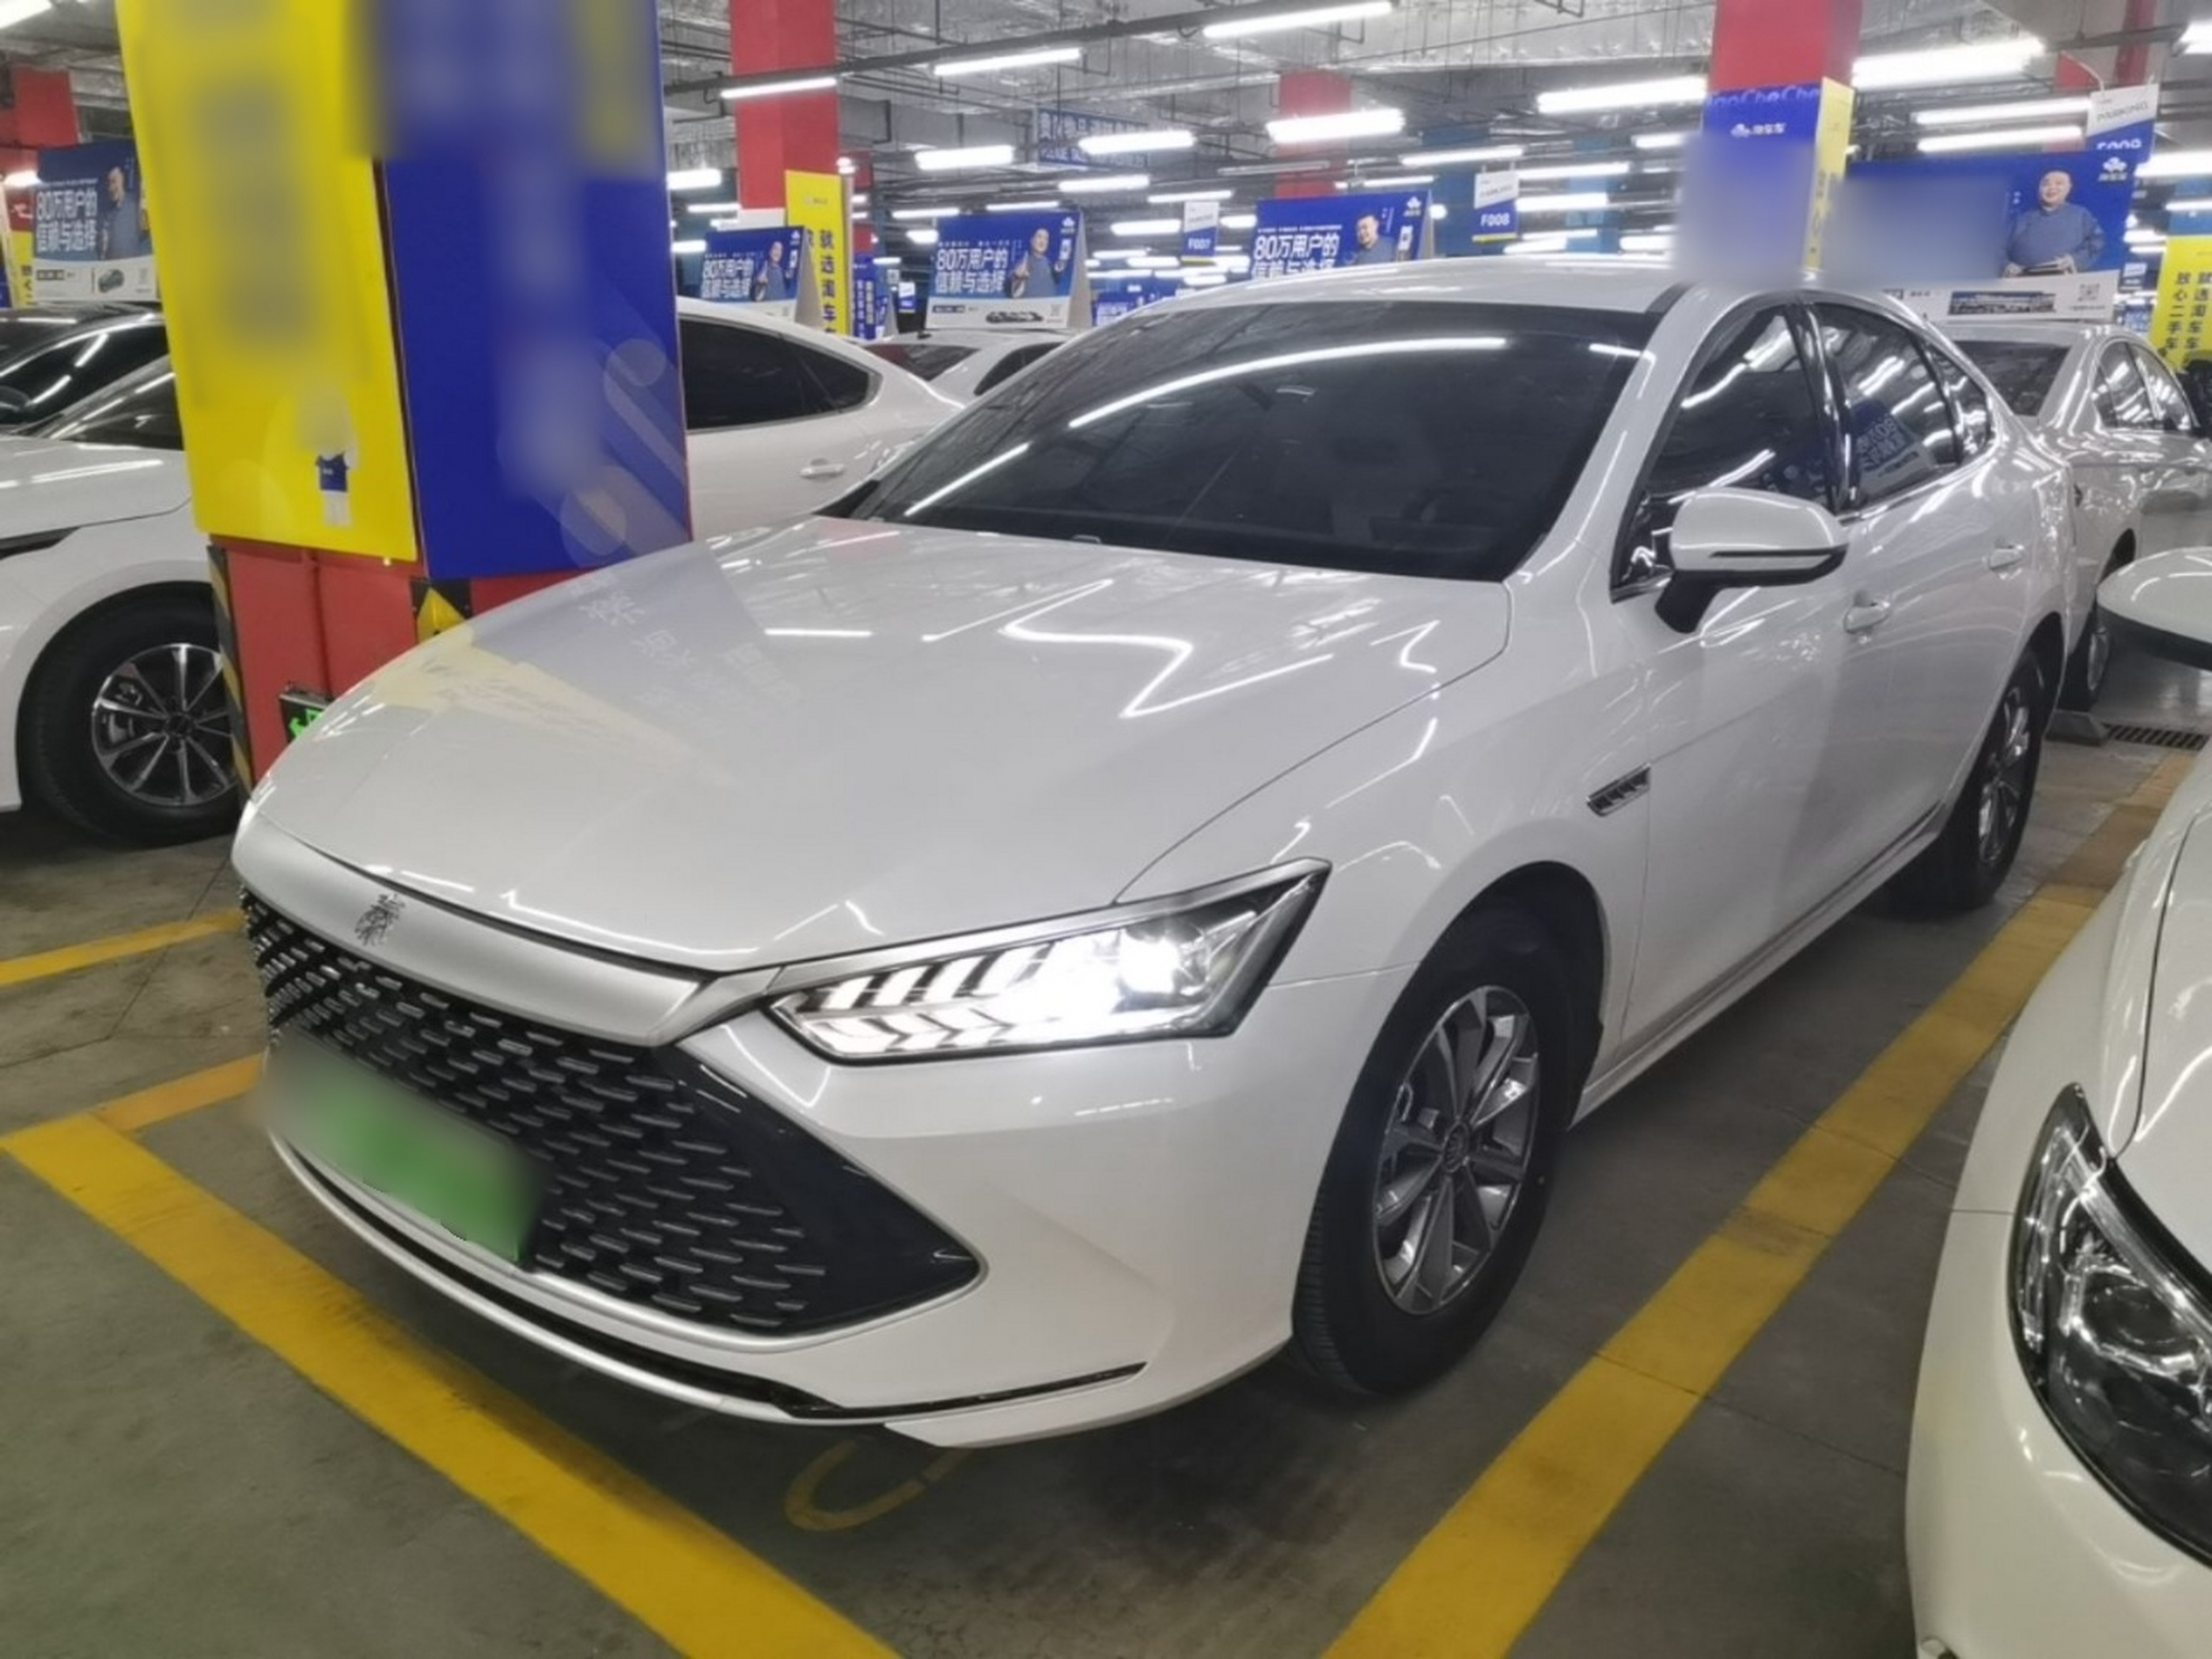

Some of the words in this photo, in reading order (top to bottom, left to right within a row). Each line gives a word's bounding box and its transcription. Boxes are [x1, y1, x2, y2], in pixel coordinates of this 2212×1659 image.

[1188, 238, 1211, 250] F007
[1254, 232, 1340, 260] 80万用户的
[936, 248, 1008, 271] 80万用户的
[935, 270, 1006, 294] 信赖与选择
